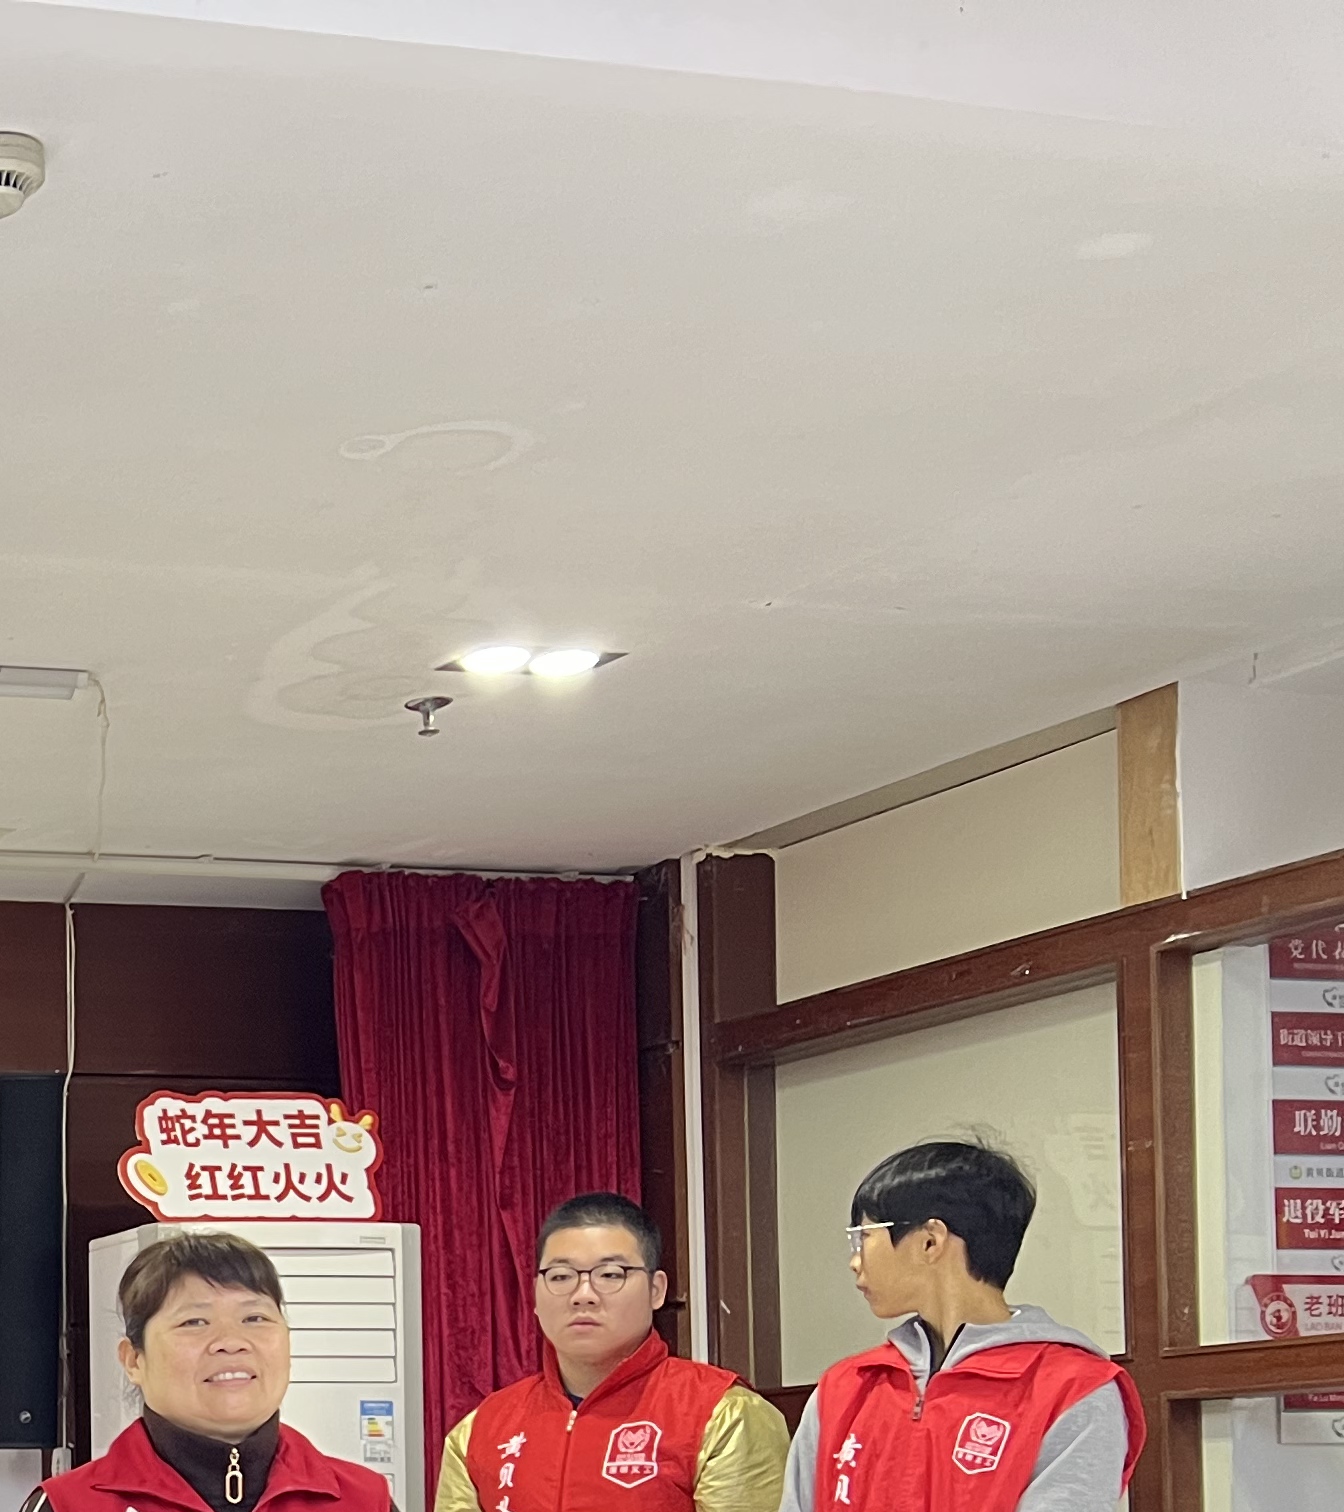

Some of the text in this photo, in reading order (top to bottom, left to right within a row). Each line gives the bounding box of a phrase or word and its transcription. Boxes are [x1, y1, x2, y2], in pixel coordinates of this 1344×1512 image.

[157, 1108, 325, 1150] 蛇年大吉
[1294, 1109, 1342, 1136] 联勤
[184, 1162, 354, 1203] 红红火火
